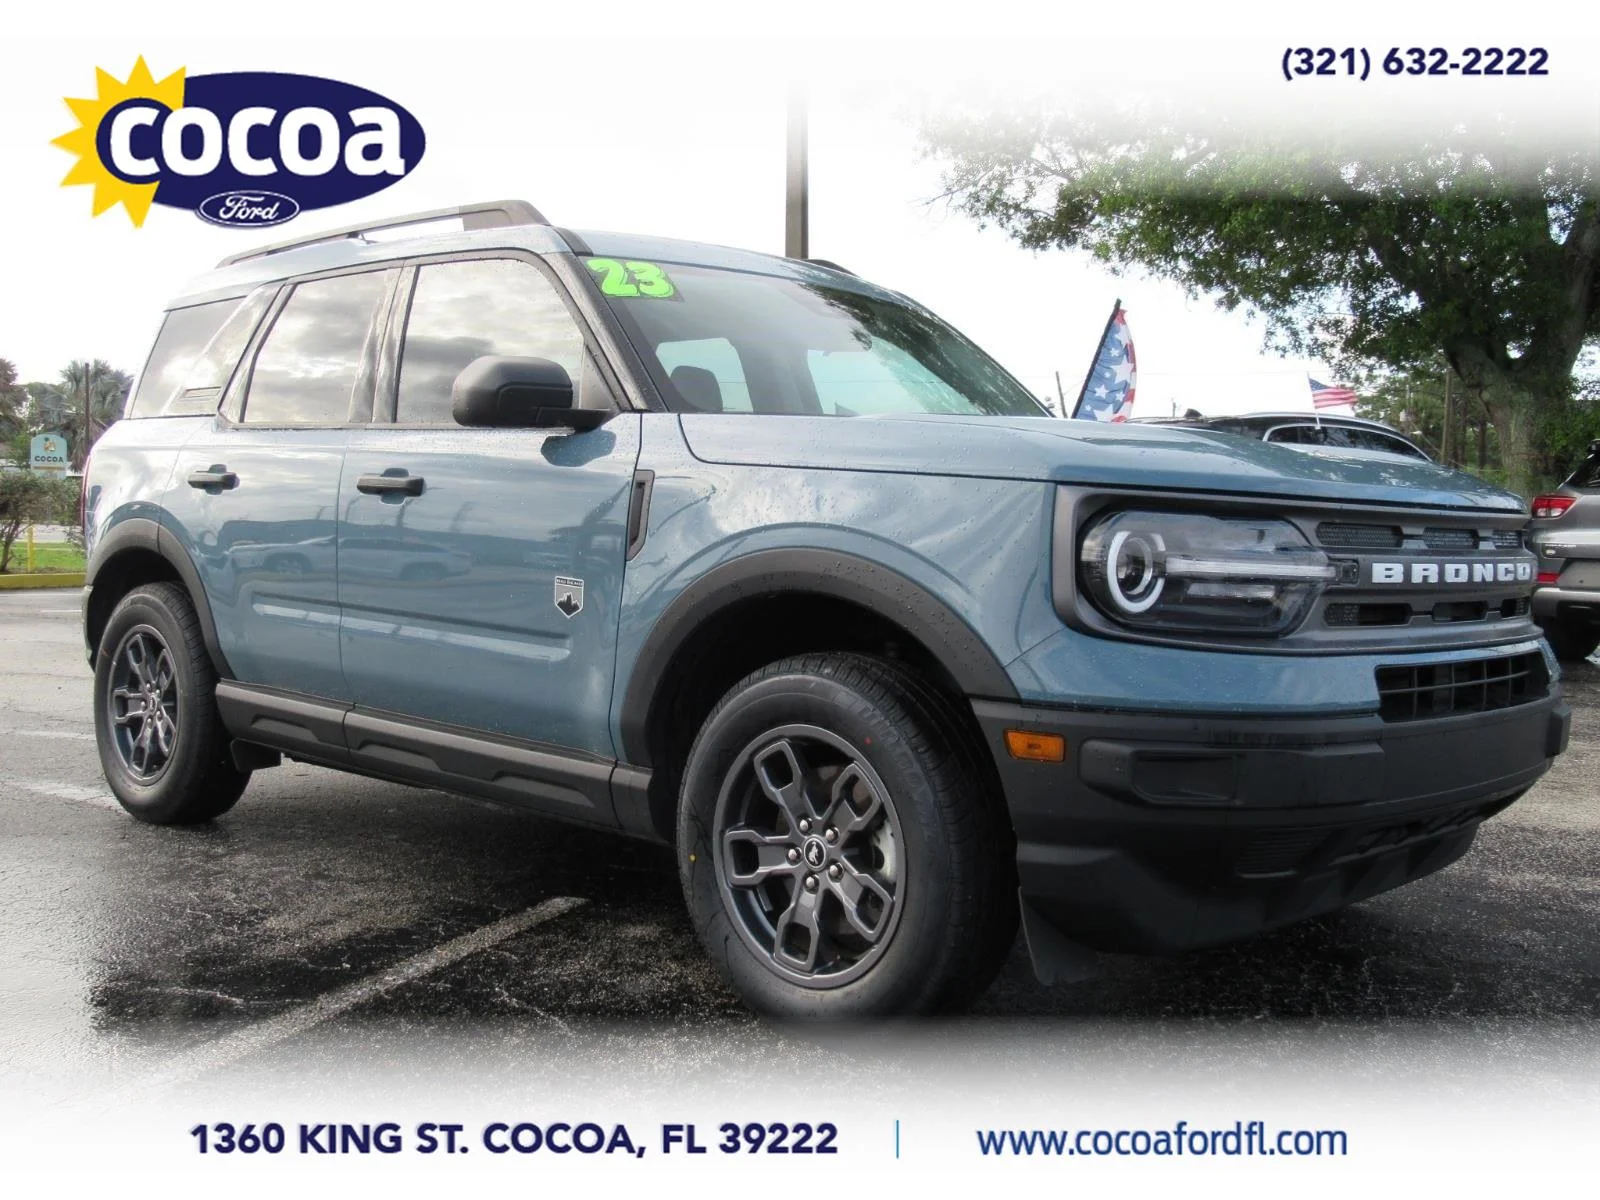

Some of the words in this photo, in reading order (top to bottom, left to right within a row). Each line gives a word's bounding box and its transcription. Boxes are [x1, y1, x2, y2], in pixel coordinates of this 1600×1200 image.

[586, 258, 674, 297] 23
[34, 455, 65, 463] COCOA
[1372, 563, 1531, 583] BRONCO
